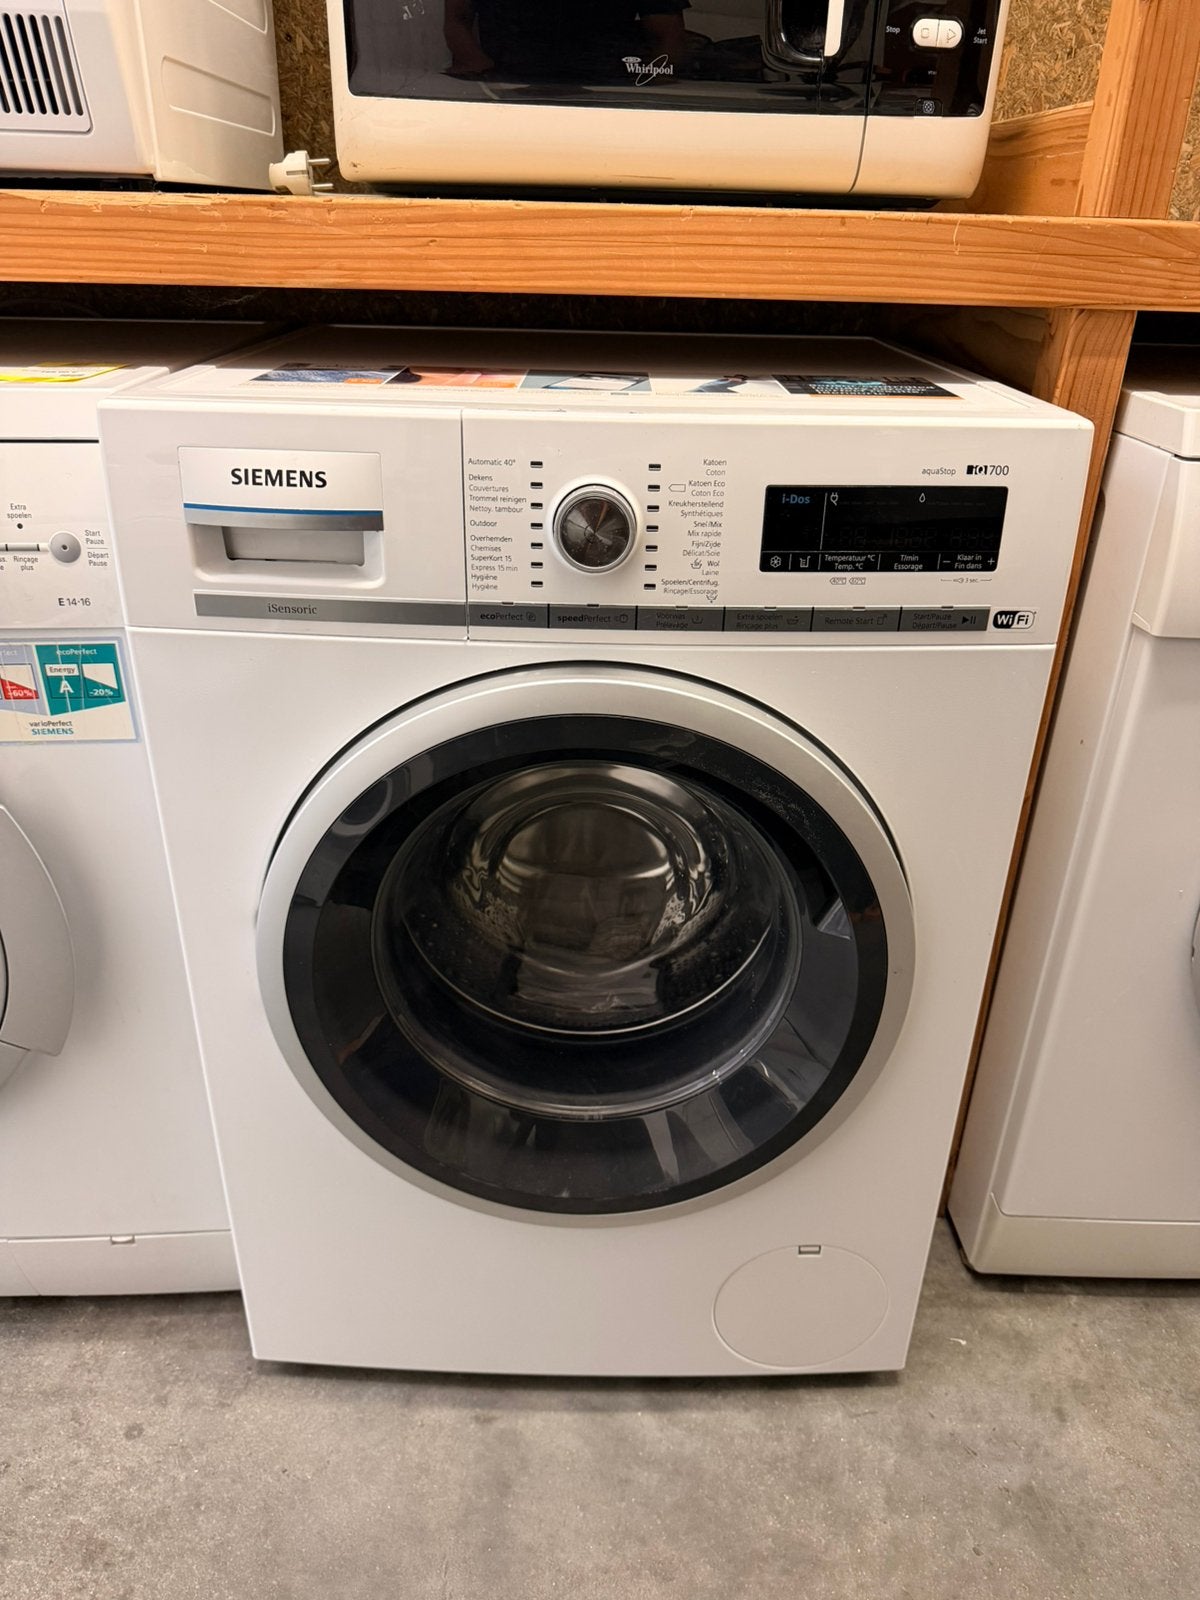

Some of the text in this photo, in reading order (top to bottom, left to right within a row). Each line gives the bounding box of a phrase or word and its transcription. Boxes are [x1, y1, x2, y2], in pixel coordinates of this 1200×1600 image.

[885, 26, 901, 34] Stop
[977, 27, 986, 35] Jet
[973, 37, 988, 45] Start
[625, 62, 674, 78] Whirlpool
[468, 458, 502, 466] Automatic
[705, 468, 726, 476] Coton
[921, 467, 957, 477] aquaStop
[230, 467, 328, 488] SIEMENS
[468, 484, 509, 492] Couvertures
[691, 489, 711, 497] Coton
[469, 494, 527, 504] Trommel reinigen
[781, 493, 810, 504] i-Dos
[10, 503, 27, 511] Extra
[494, 505, 523, 513] tambour
[7, 512, 32, 521] spoelen
[681, 509, 723, 518] Synthétiques
[469, 519, 497, 527] Outdoor
[84, 529, 101, 537] Start
[700, 530, 721, 538] rapide
[470, 534, 512, 542] Overhemden
[470, 544, 501, 552] Chemises
[87, 551, 109, 560] Départ
[470, 553, 503, 562] SuperKort
[825, 554, 866, 562] Temperatuur
[13, 556, 38, 565] Rinçage
[20, 564, 34, 572] plus
[471, 563, 496, 572] Express
[894, 563, 923, 571] Essorage
[58, 598, 65, 606] E
[267, 603, 318, 615] iSensoric
[480, 612, 523, 621] ecoPerfect
[557, 613, 611, 624] speedPerfect
[824, 616, 874, 625] Remote Start
[60, 679, 74, 693] A
[89, 688, 113, 696] -20%
[29, 720, 73, 728] varioPerfect
